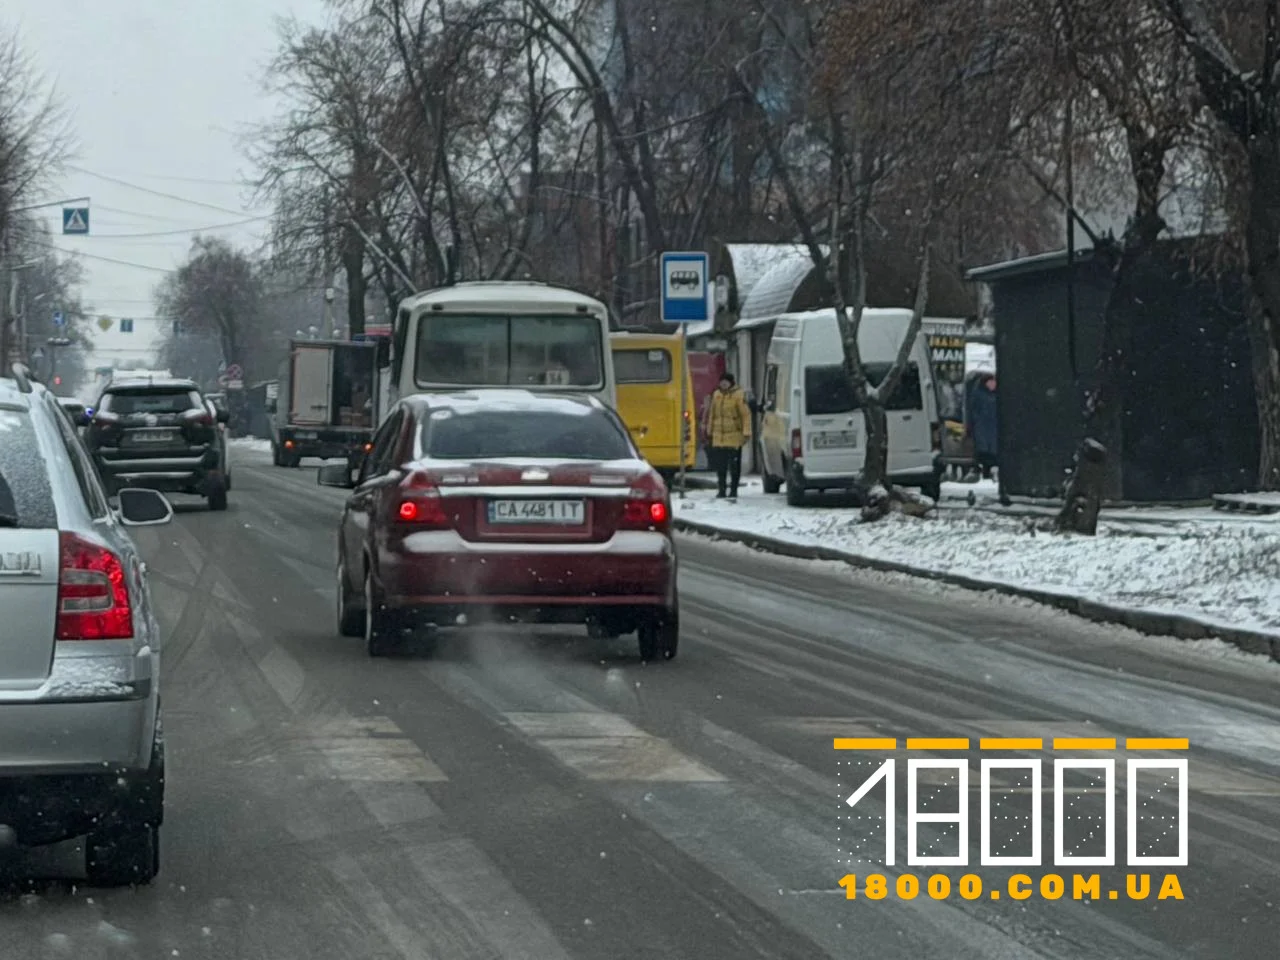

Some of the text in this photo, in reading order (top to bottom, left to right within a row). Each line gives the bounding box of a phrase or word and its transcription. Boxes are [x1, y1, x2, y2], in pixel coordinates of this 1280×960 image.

[497, 501, 580, 518] CA 4481 IT
